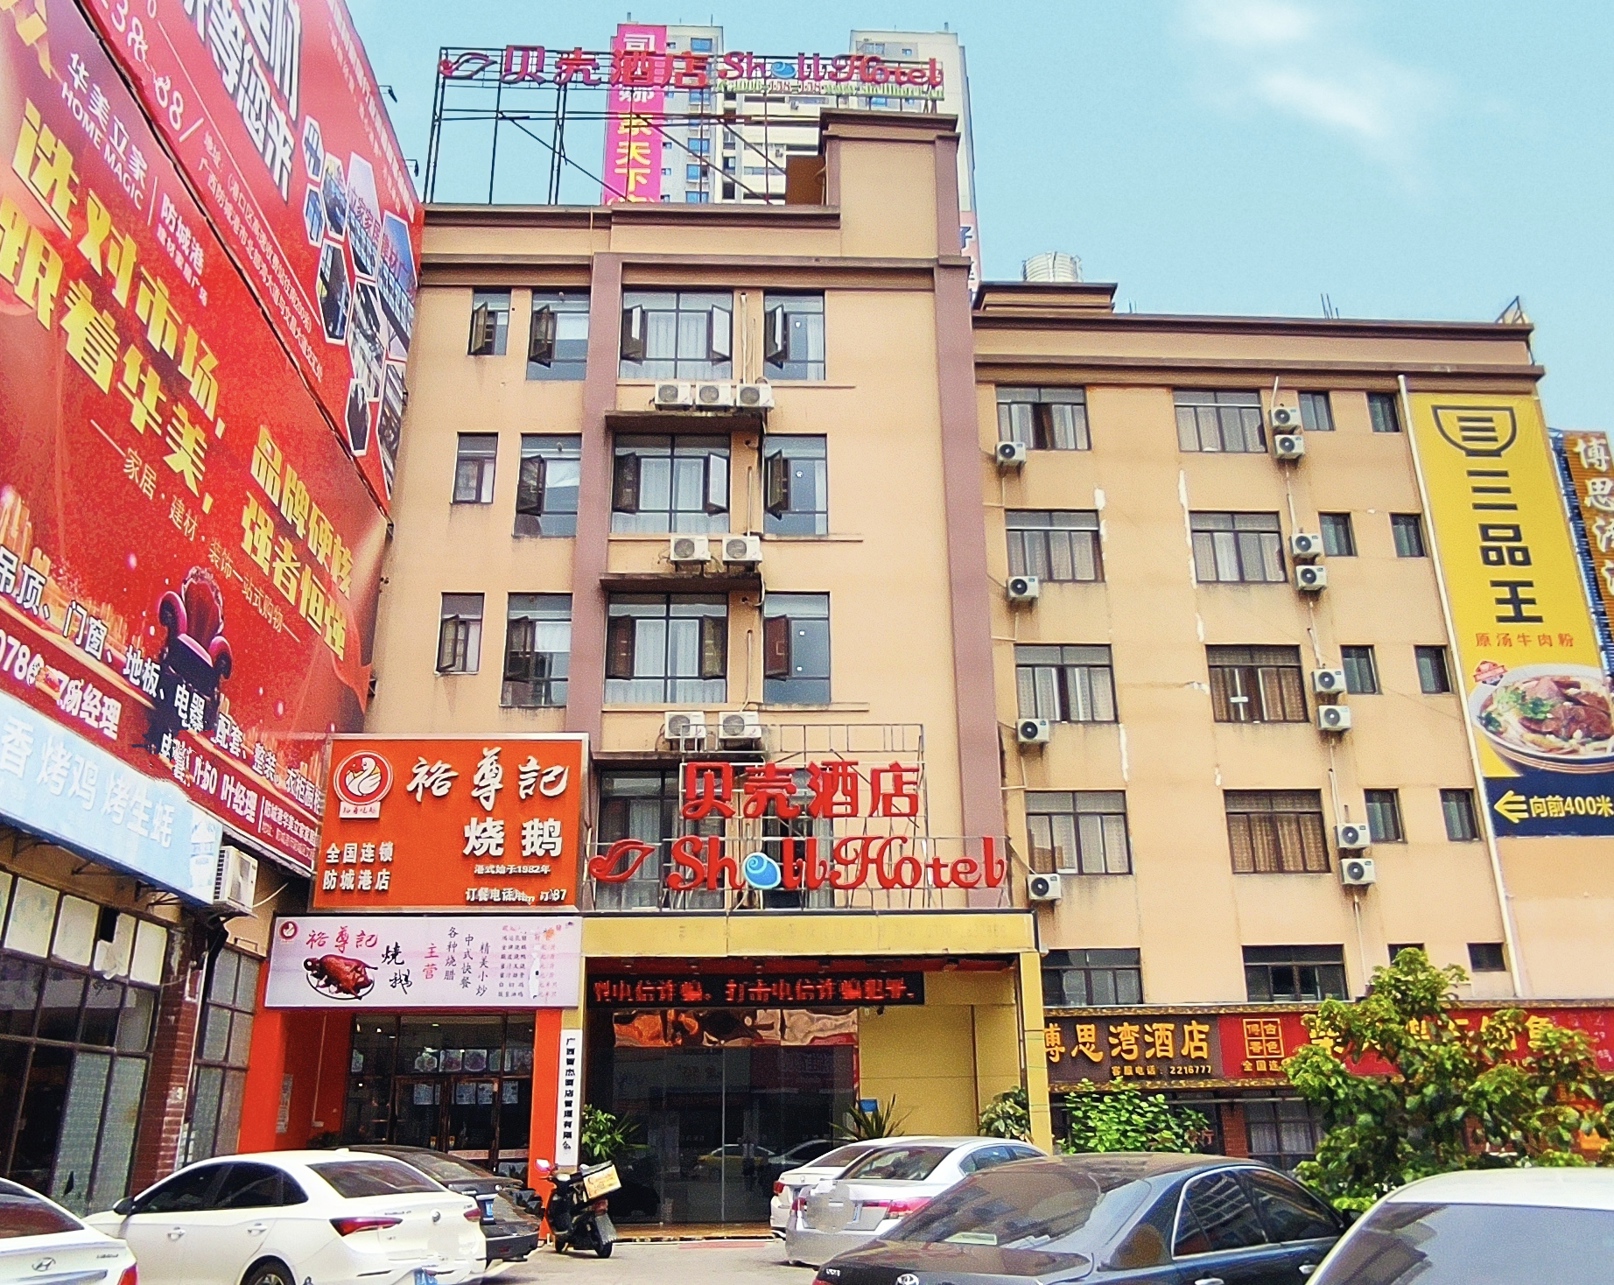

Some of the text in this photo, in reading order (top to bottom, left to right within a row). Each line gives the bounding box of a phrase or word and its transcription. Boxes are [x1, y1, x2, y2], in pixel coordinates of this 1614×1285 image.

[500, 44, 709, 88] 贝壳酒店
[828, 54, 945, 87] Hotel
[61, 81, 144, 210] HOME MAGIC
[67, 53, 148, 190] 华美立家
[161, 192, 205, 277] 防城港
[250, 424, 354, 600] 品牌硬核
[1465, 469, 1544, 624] 三品王
[240, 490, 347, 661] 强者恒强
[1475, 632, 1574, 648] 原汤牛肉粉
[37, 734, 100, 812] 烤鸡
[101, 771, 176, 849] 烤生蚝
[680, 759, 921, 820] 贝壳酒店
[1528, 794, 1614, 818] 向前400米
[325, 841, 395, 865] 全国连锁
[462, 816, 564, 858] 烧鹅
[829, 835, 1008, 890] Hotel
[322, 867, 392, 892] 防城港店
[421, 942, 440, 981] 主营
[459, 933, 474, 990] 中式快餐
[475, 941, 491, 998] 精美小炒
[1043, 1020, 1210, 1063] 博思湾酒店
[1169, 1065, 1212, 1075] 2216777
